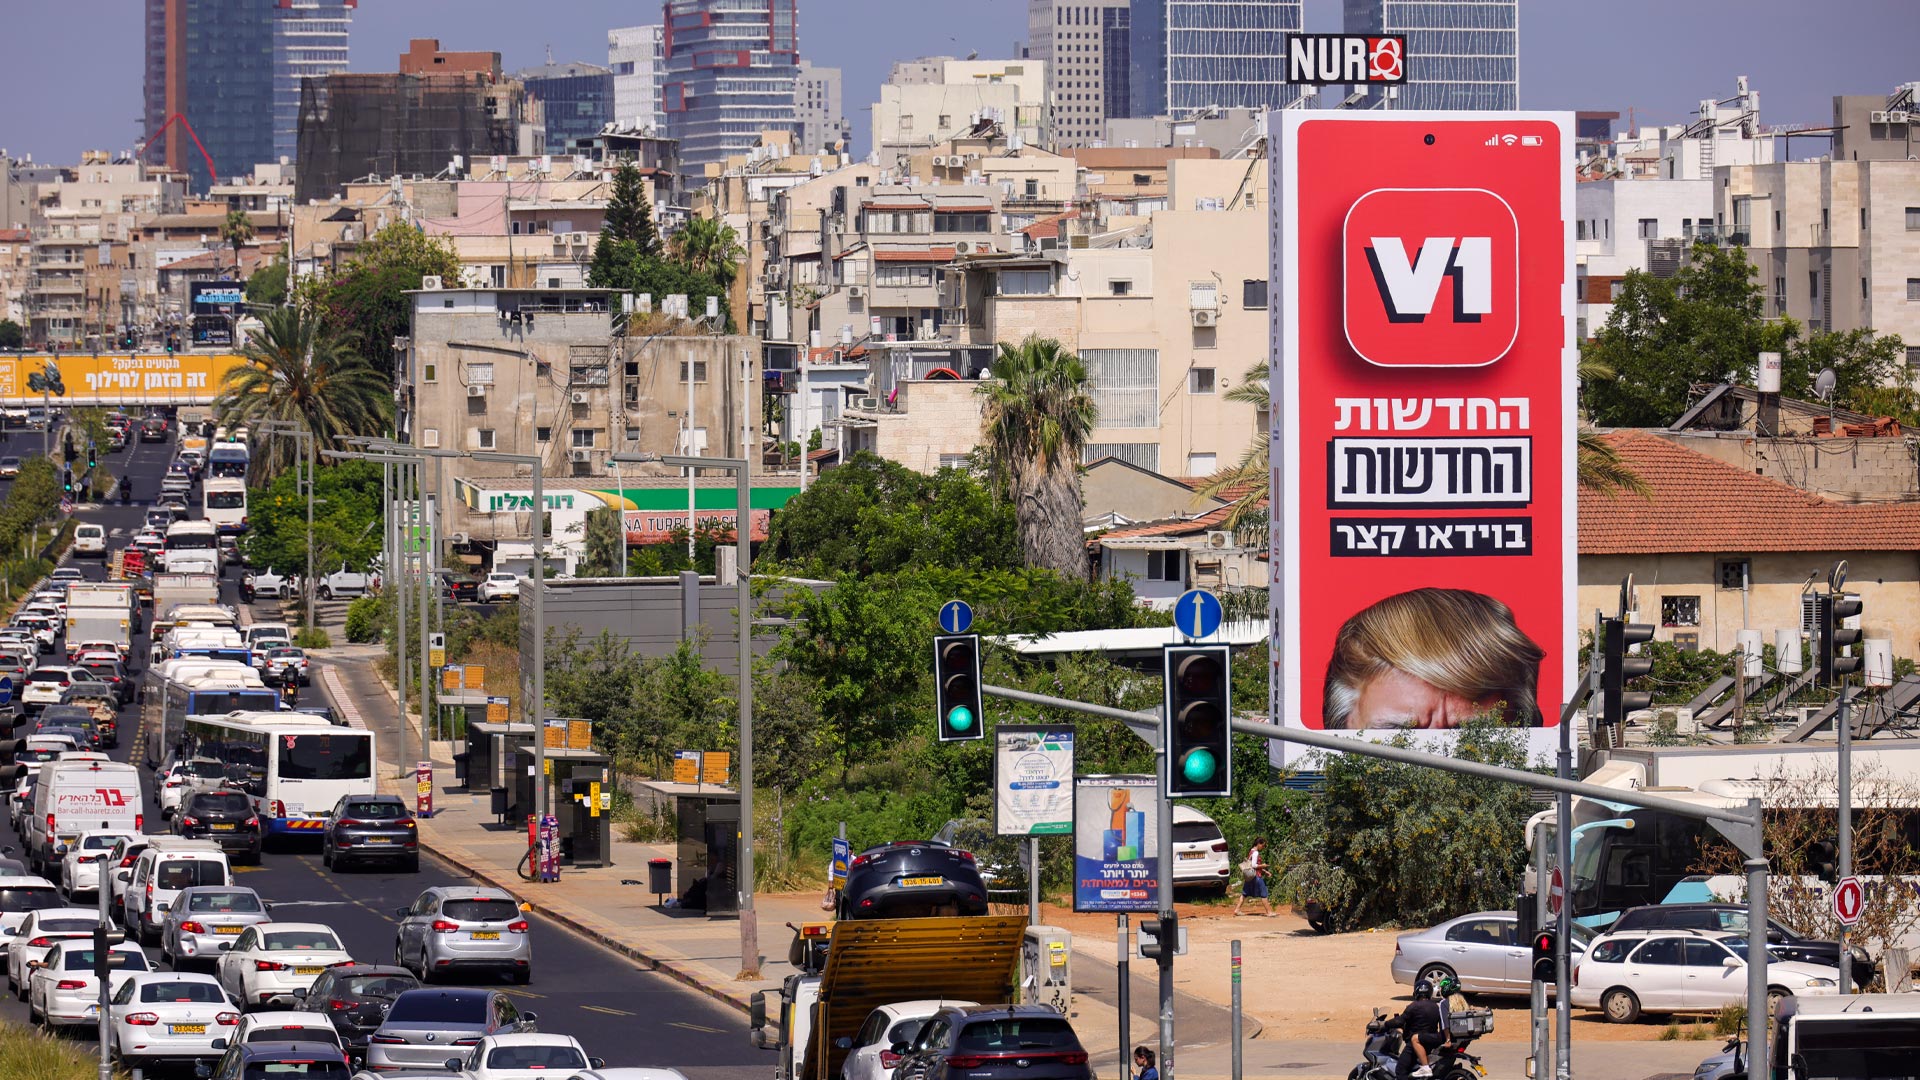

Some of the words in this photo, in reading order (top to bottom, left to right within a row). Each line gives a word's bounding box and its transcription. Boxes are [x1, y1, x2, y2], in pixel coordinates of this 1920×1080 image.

[1290, 37, 1366, 81] NUR
[1364, 237, 1492, 323] V1
[112, 357, 144, 370] בפקק?
[145, 359, 180, 370] תקועים
[85, 370, 140, 391] לחילוף
[144, 372, 182, 391] הזמן
[186, 372, 207, 388] זה
[1334, 397, 1530, 430] החדשות
[1341, 446, 1522, 495] החדשות
[489, 492, 535, 512] אלון
[542, 494, 574, 509] דור
[1336, 524, 1407, 555] קצר
[1415, 523, 1527, 549] בוידאו
[58, 794, 88, 805] הארץ
[89, 794, 101, 803] כל
[95, 788, 126, 806] בר
[57, 807, 126, 815] Bar-call-haaretz.co.il
[1100, 869, 1125, 879] ויותר
[1127, 869, 1149, 879] יותר
[1081, 877, 1130, 889] למאוחדת
